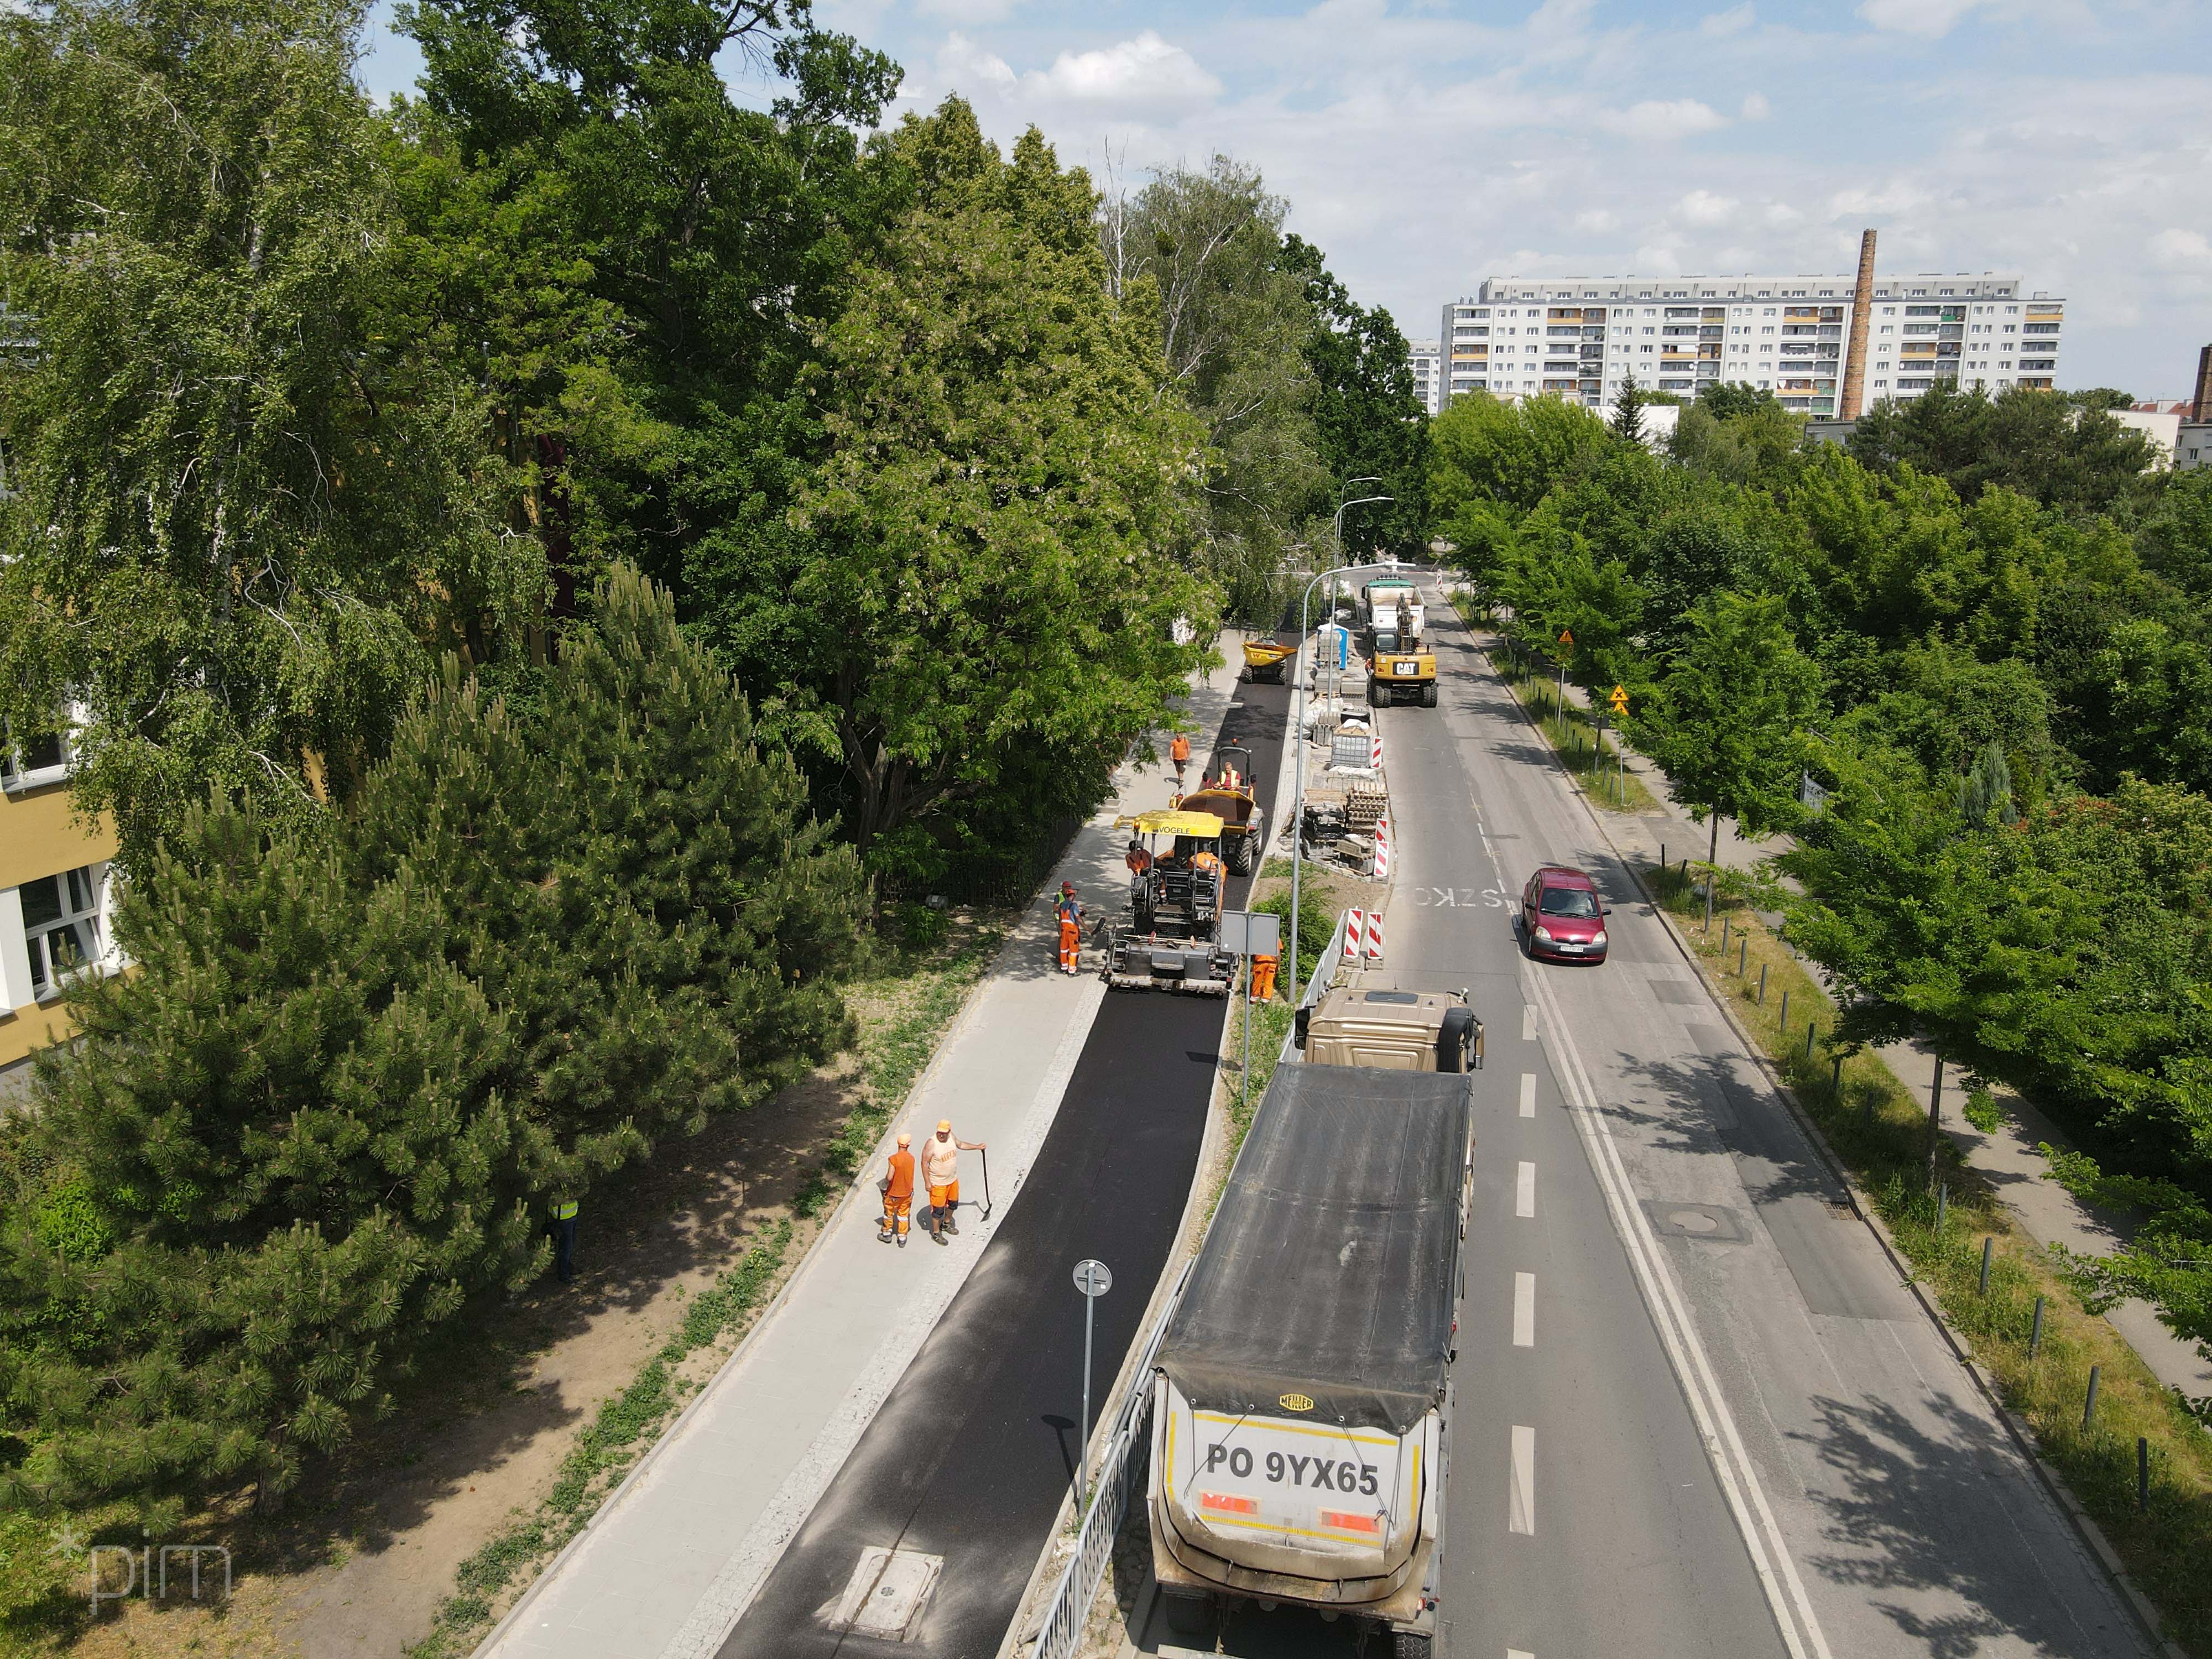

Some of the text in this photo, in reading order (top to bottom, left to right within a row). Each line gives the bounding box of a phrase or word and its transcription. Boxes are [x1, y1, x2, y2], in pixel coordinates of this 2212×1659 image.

[1396, 662, 1416, 674] CAT
[1281, 1395, 1312, 1410] MEILLER
[1207, 1443, 1378, 1496] PO 9YX65
